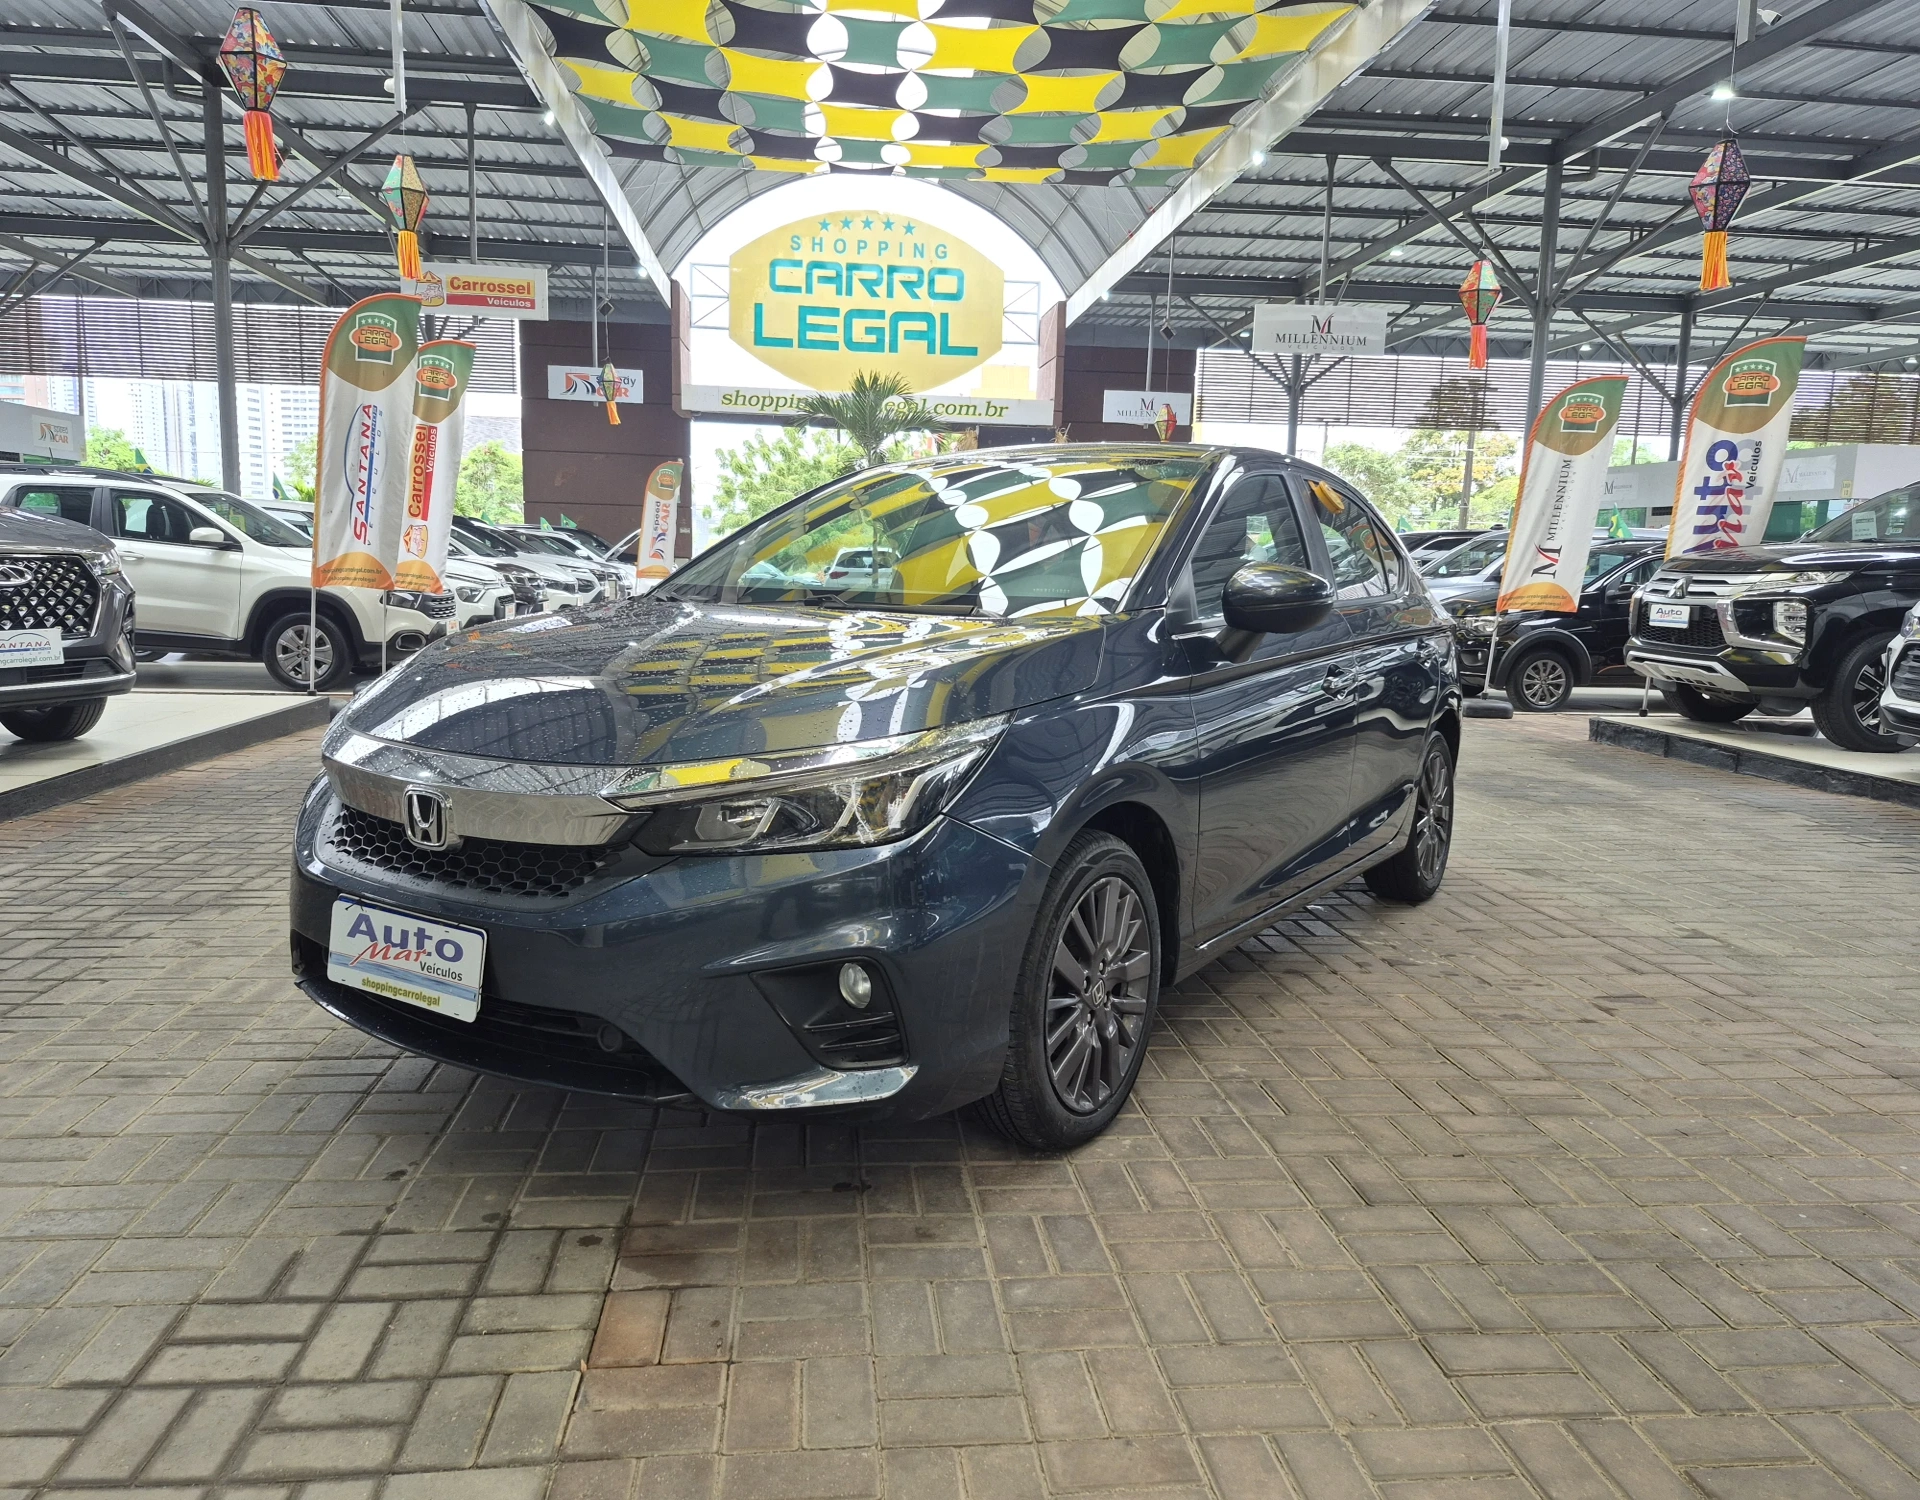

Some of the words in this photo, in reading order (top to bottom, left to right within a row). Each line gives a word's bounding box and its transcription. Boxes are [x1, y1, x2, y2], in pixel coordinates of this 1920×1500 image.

[790, 235, 948, 259] SHOPPING
[449, 276, 531, 295] Carrossel
[769, 258, 965, 302] CARRO
[487, 297, 531, 308] Veículos
[360, 328, 392, 340] CARRO
[753, 302, 979, 356] LEGAL
[358, 335, 393, 348] LEGAL
[1275, 333, 1367, 346] MILLENNIUM
[421, 374, 451, 387] LEGAL
[422, 368, 450, 379] CARRO
[596, 375, 637, 388] sdy
[1732, 374, 1770, 383] CARRO
[1729, 381, 1771, 391] LEGAL
[1116, 409, 1178, 419] MILLENN
[1565, 411, 1599, 420] LEGAL
[54, 434, 69, 444] CAR
[408, 425, 428, 518] Carrossel
[1745, 440, 1763, 490] Veículos
[353, 404, 373, 546] SANTANA
[1546, 458, 1573, 542] MILLENNIUM
[653, 501, 661, 532] speed
[660, 502, 671, 534] CAR
[1656, 607, 1683, 616] Auto
[346, 912, 464, 963] Auto
[349, 940, 427, 967] Mar
[419, 960, 463, 982] Veículos
[361, 976, 441, 1007] shoppingcarrolegal
